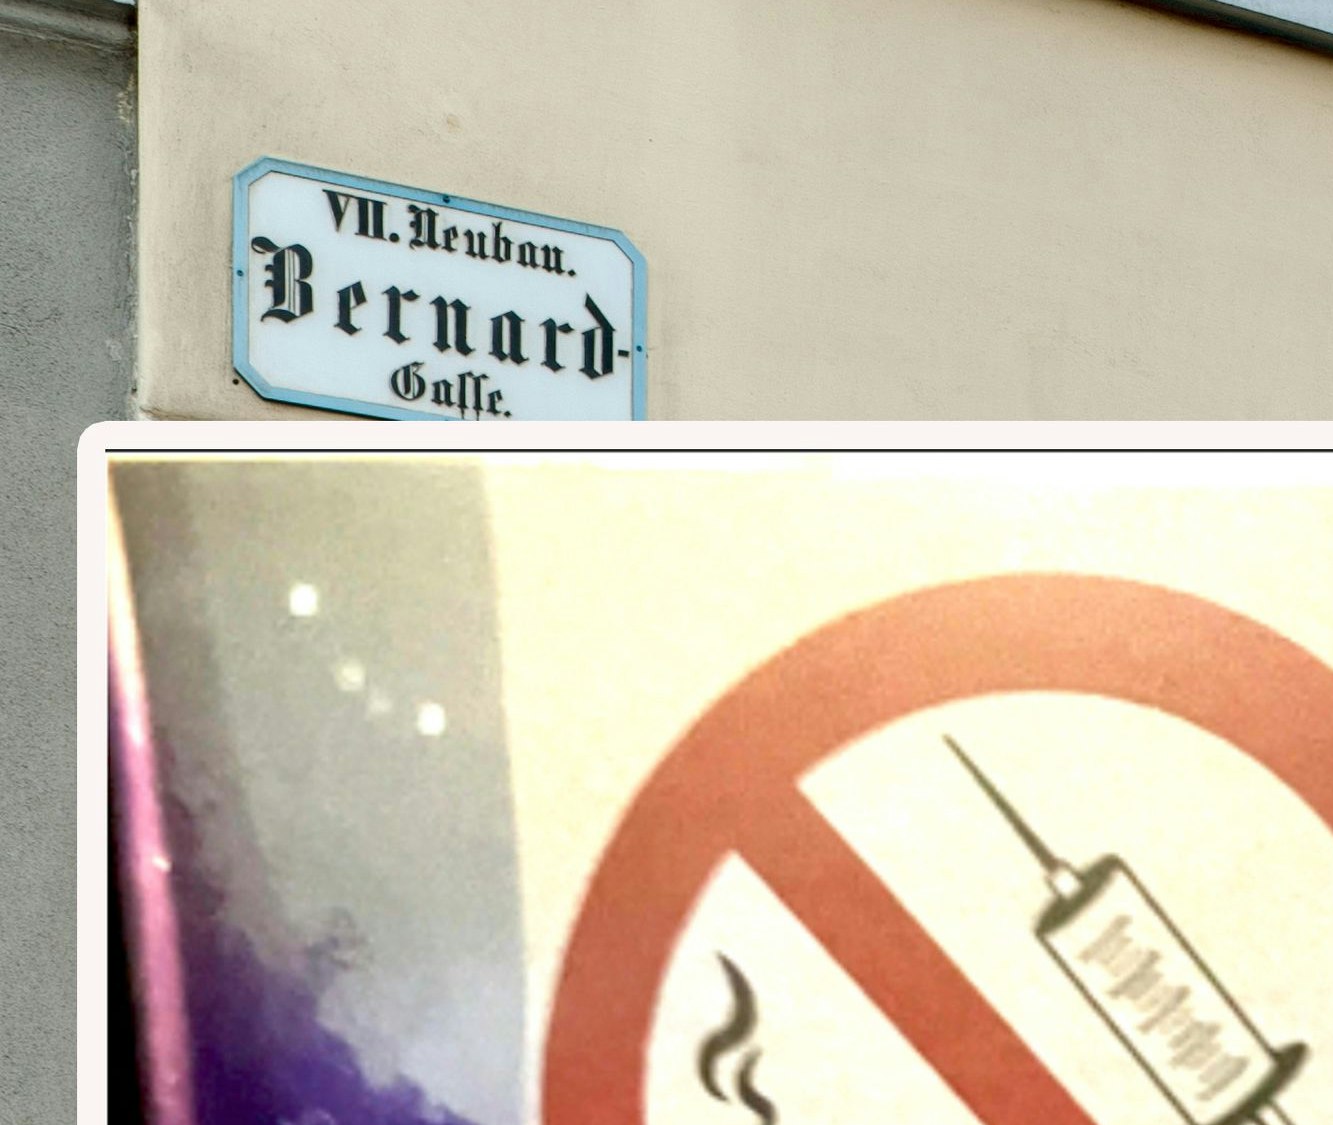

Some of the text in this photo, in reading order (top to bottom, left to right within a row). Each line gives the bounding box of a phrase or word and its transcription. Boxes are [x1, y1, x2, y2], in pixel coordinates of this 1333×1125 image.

[322, 188, 577, 278] VII. Neubau.
[250, 236, 630, 380] Bernard-
